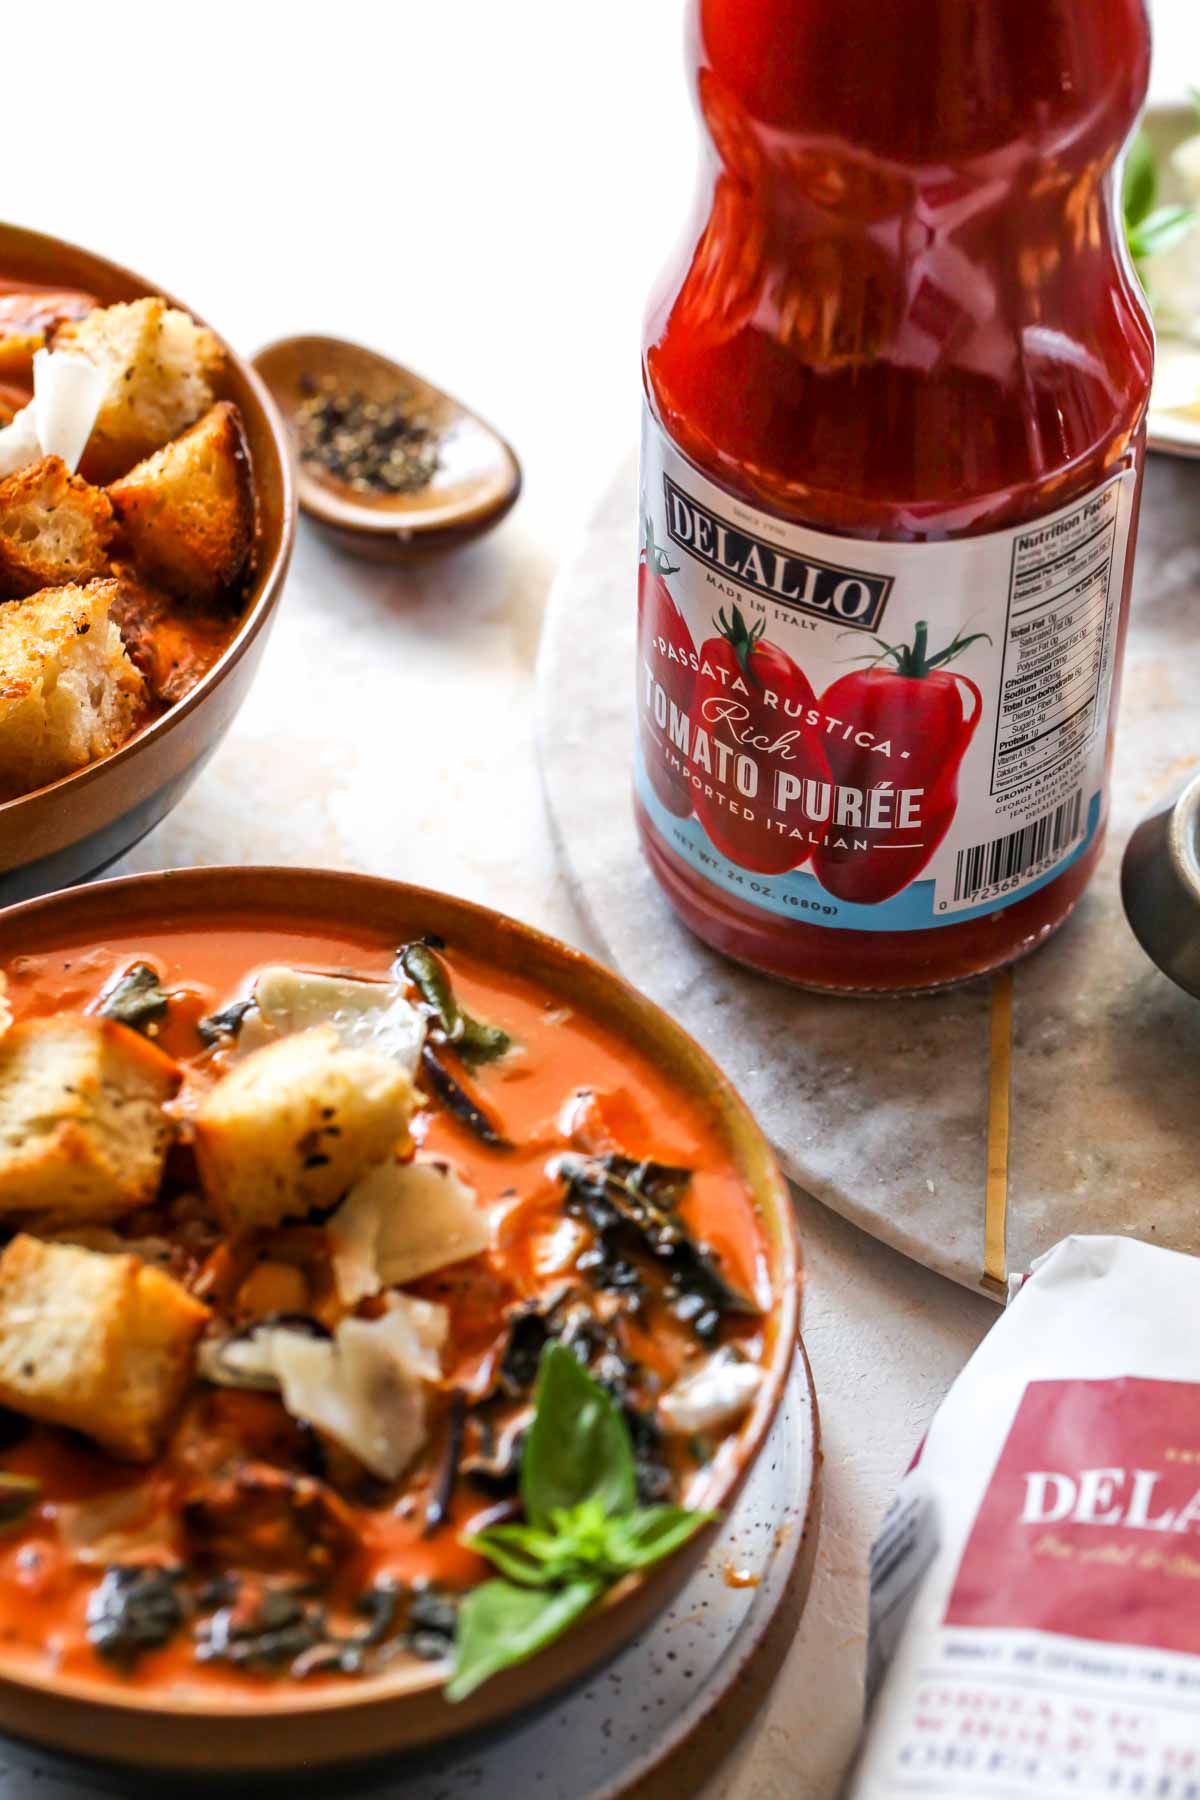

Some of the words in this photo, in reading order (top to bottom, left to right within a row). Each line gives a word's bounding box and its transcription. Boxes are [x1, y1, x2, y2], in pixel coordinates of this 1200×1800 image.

[1019, 515, 1080, 552] Nutrition
[671, 492, 871, 618] DELALLO
[706, 573, 743, 602] MADE
[750, 600, 766, 613] IN
[774, 609, 818, 631] ITALY
[1010, 625, 1031, 639] Total
[1032, 619, 1045, 631] Fat
[1019, 627, 1053, 648] Saturated
[1005, 662, 1052, 689] Cholesterol
[1003, 683, 1037, 701] Sodium
[1002, 700, 1023, 713] Total
[1012, 707, 1036, 722] Dietary
[701, 696, 801, 760] Rich
[1011, 719, 1036, 734] Sugars
[643, 660, 758, 798] TOMATO
[773, 769, 925, 829] PURÉE
[999, 733, 1029, 750] Protein
[995, 782, 1033, 804] GROWN
[1042, 756, 1073, 782] PACKED
[996, 765, 1018, 779] Calcium
[665, 750, 755, 821] IMPORTED
[767, 818, 869, 851] ITALIAN
[995, 795, 1034, 815] GEORGE
[673, 828, 696, 851] NET
[727, 870, 744, 884] 24
[750, 882, 776, 899] OZ.
[782, 894, 838, 915] (680g)
[939, 901, 948, 910] 0
[970, 876, 1020, 903] 72368
